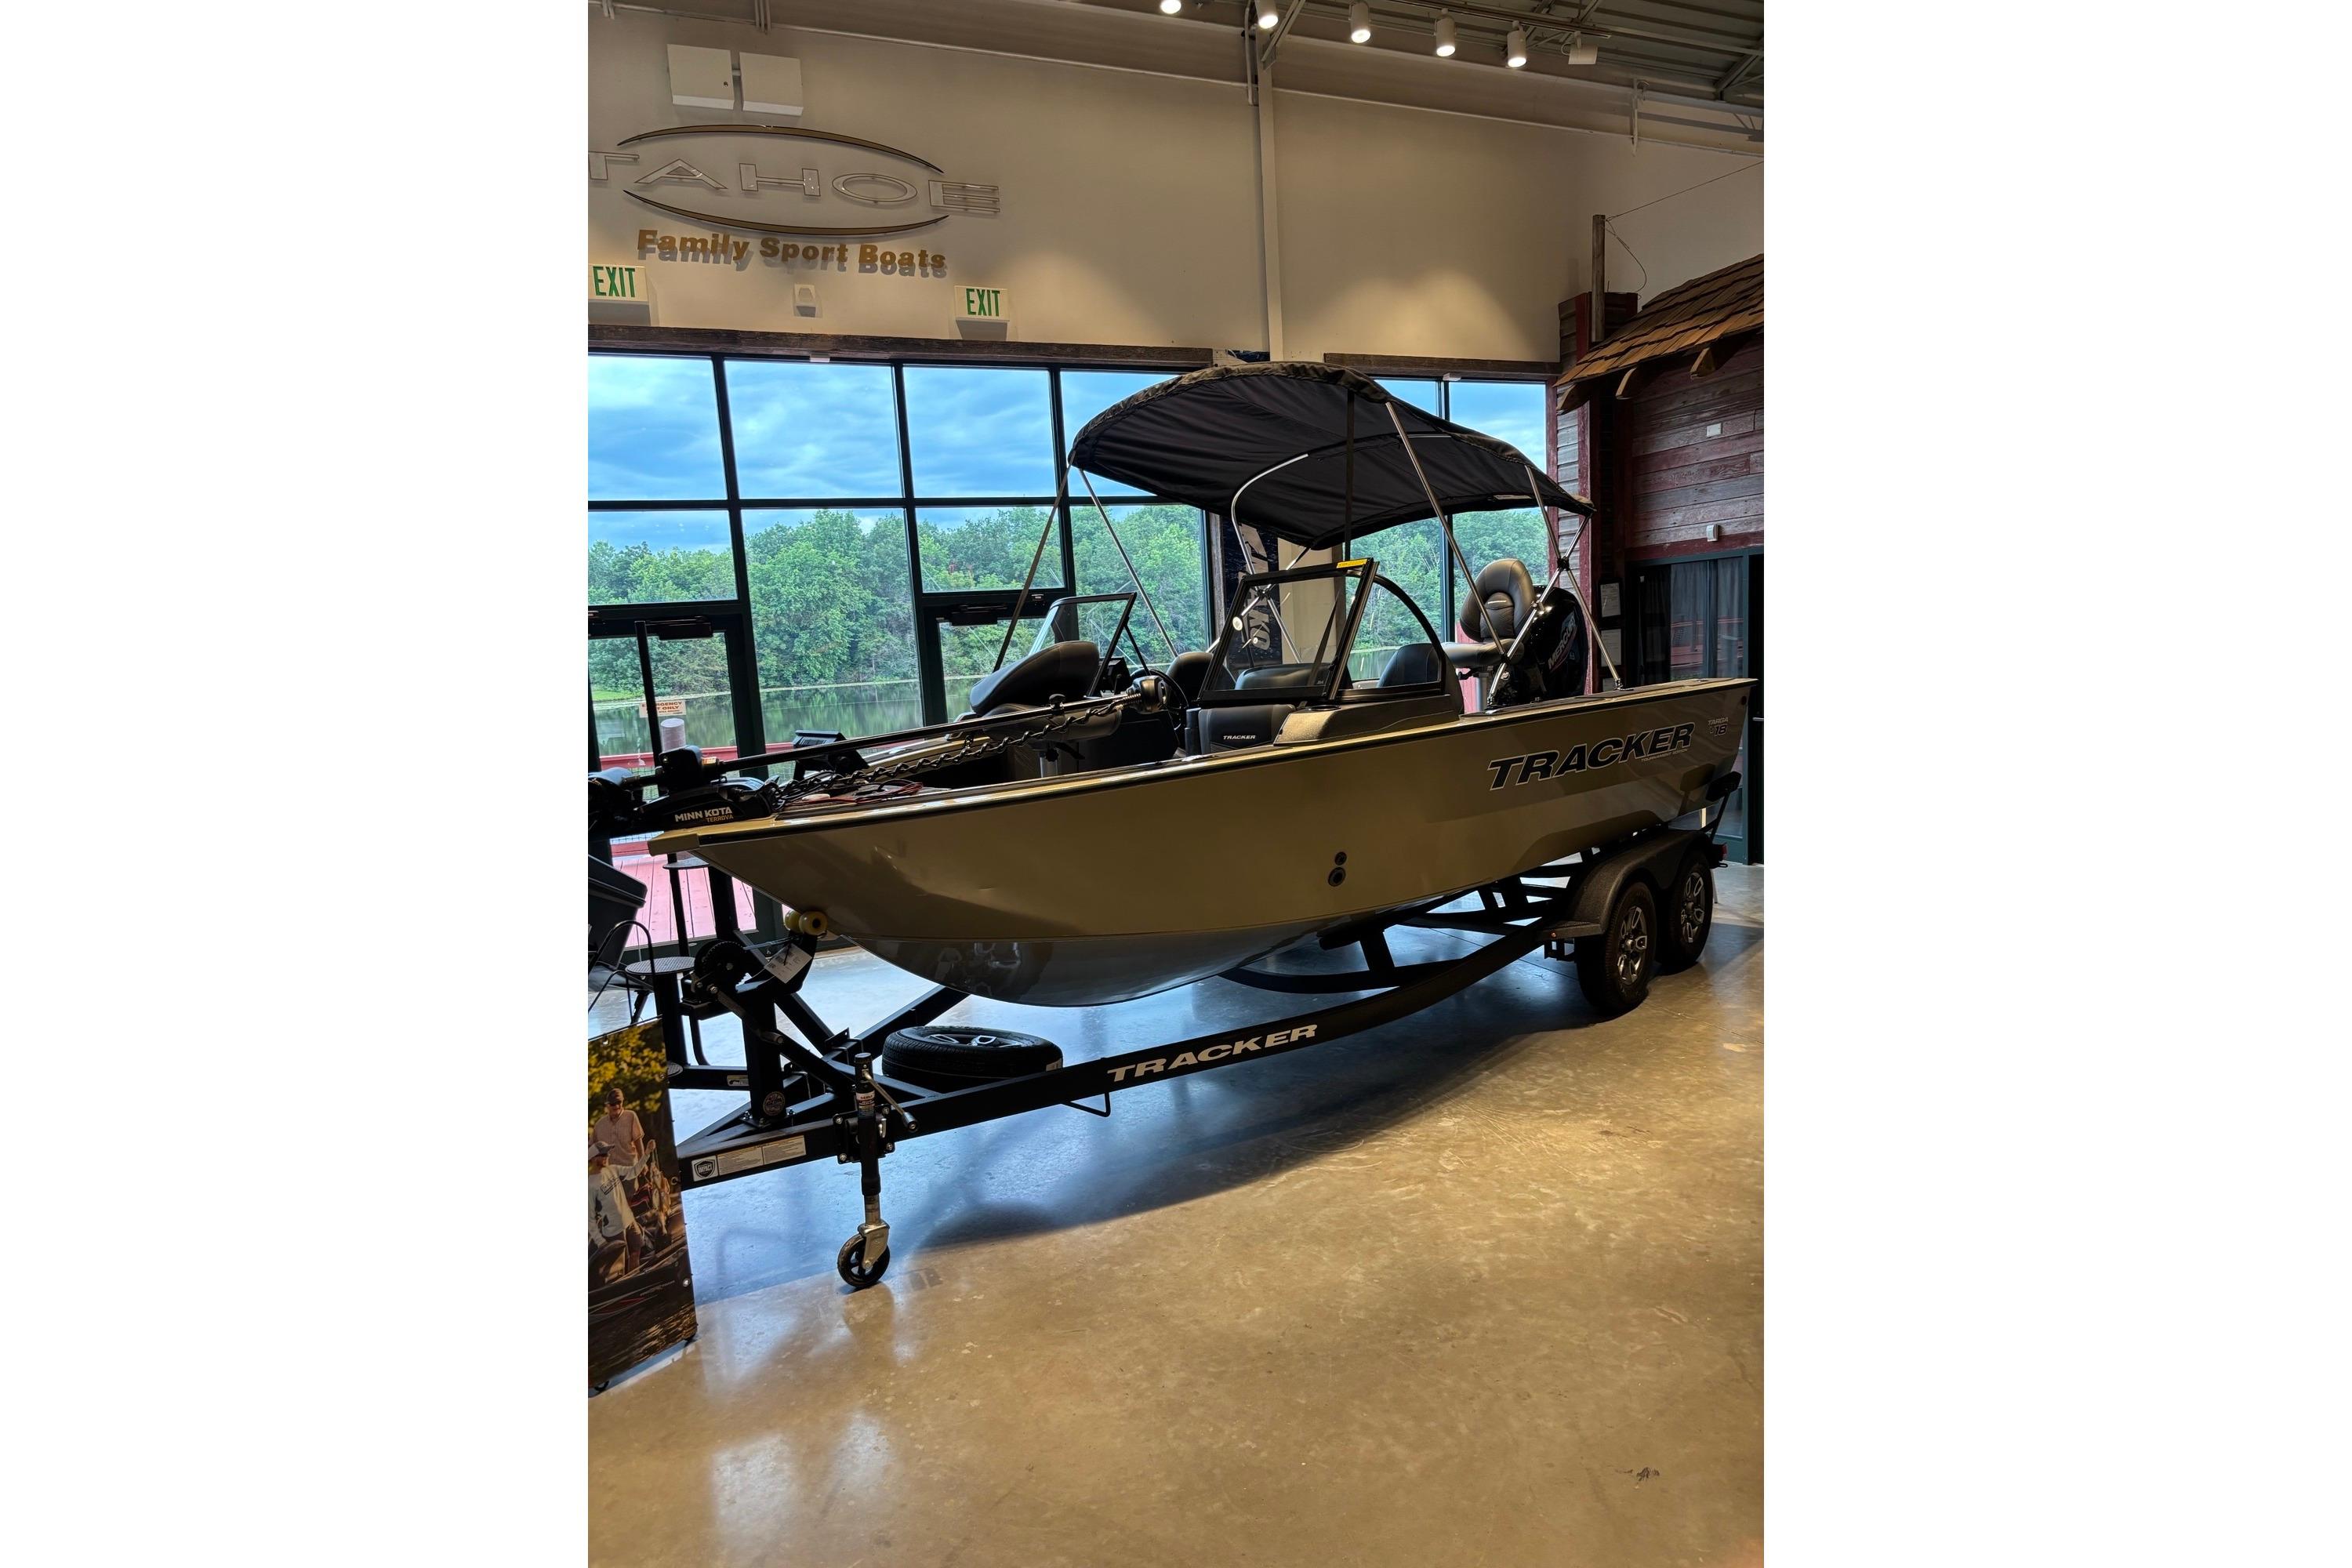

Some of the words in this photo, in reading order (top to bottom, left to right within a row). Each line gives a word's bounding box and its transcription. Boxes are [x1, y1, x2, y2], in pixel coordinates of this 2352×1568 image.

[588, 151, 1000, 212] TAHOE
[637, 229, 750, 260] Family
[759, 237, 848, 263] Sport
[858, 244, 946, 269] Boats
[593, 266, 636, 298] EXIT
[965, 288, 1000, 317] EXIT
[1487, 722, 1696, 791] TRACKER
[674, 810, 703, 822] MINN
[704, 806, 732, 818] KOTA
[706, 814, 734, 822] TERROVA
[1106, 1024, 1318, 1083] TRACKER
